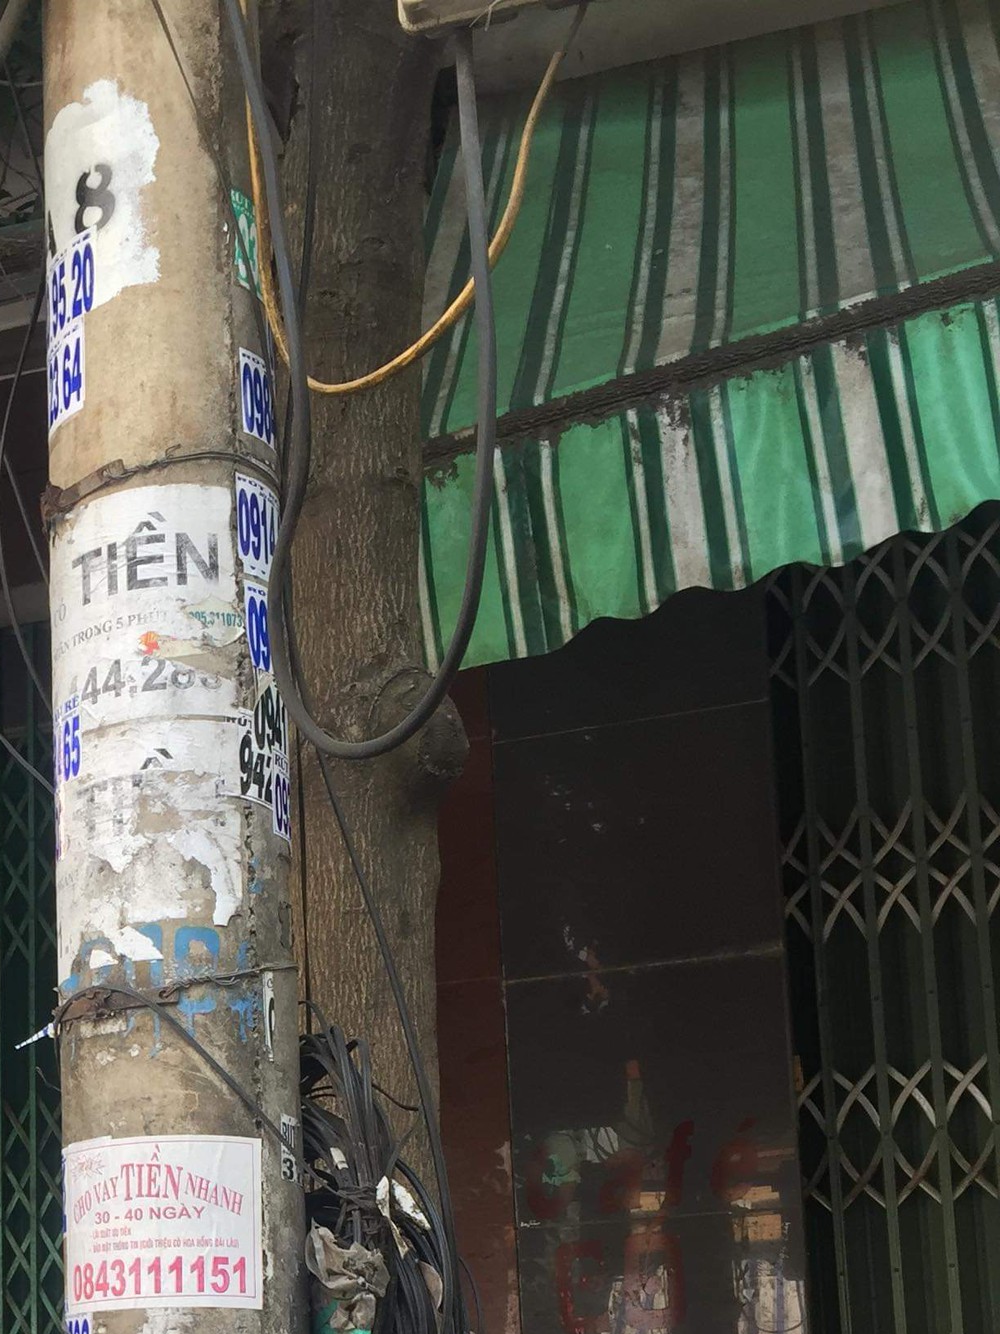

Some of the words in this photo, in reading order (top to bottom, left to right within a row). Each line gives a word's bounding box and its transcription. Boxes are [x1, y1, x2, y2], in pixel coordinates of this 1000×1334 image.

[71, 511, 220, 607] TIỀN
[115, 615, 125, 630] 5
[73, 1190, 92, 1225] CHO
[93, 1176, 119, 1204] VAY
[120, 1143, 184, 1201] TIỀN
[185, 1172, 244, 1216] NHANH
[95, 1210, 110, 1225] 30
[124, 1207, 144, 1221] 40
[149, 1202, 206, 1220] NGÀY
[73, 1256, 247, 1302] 0843111151
